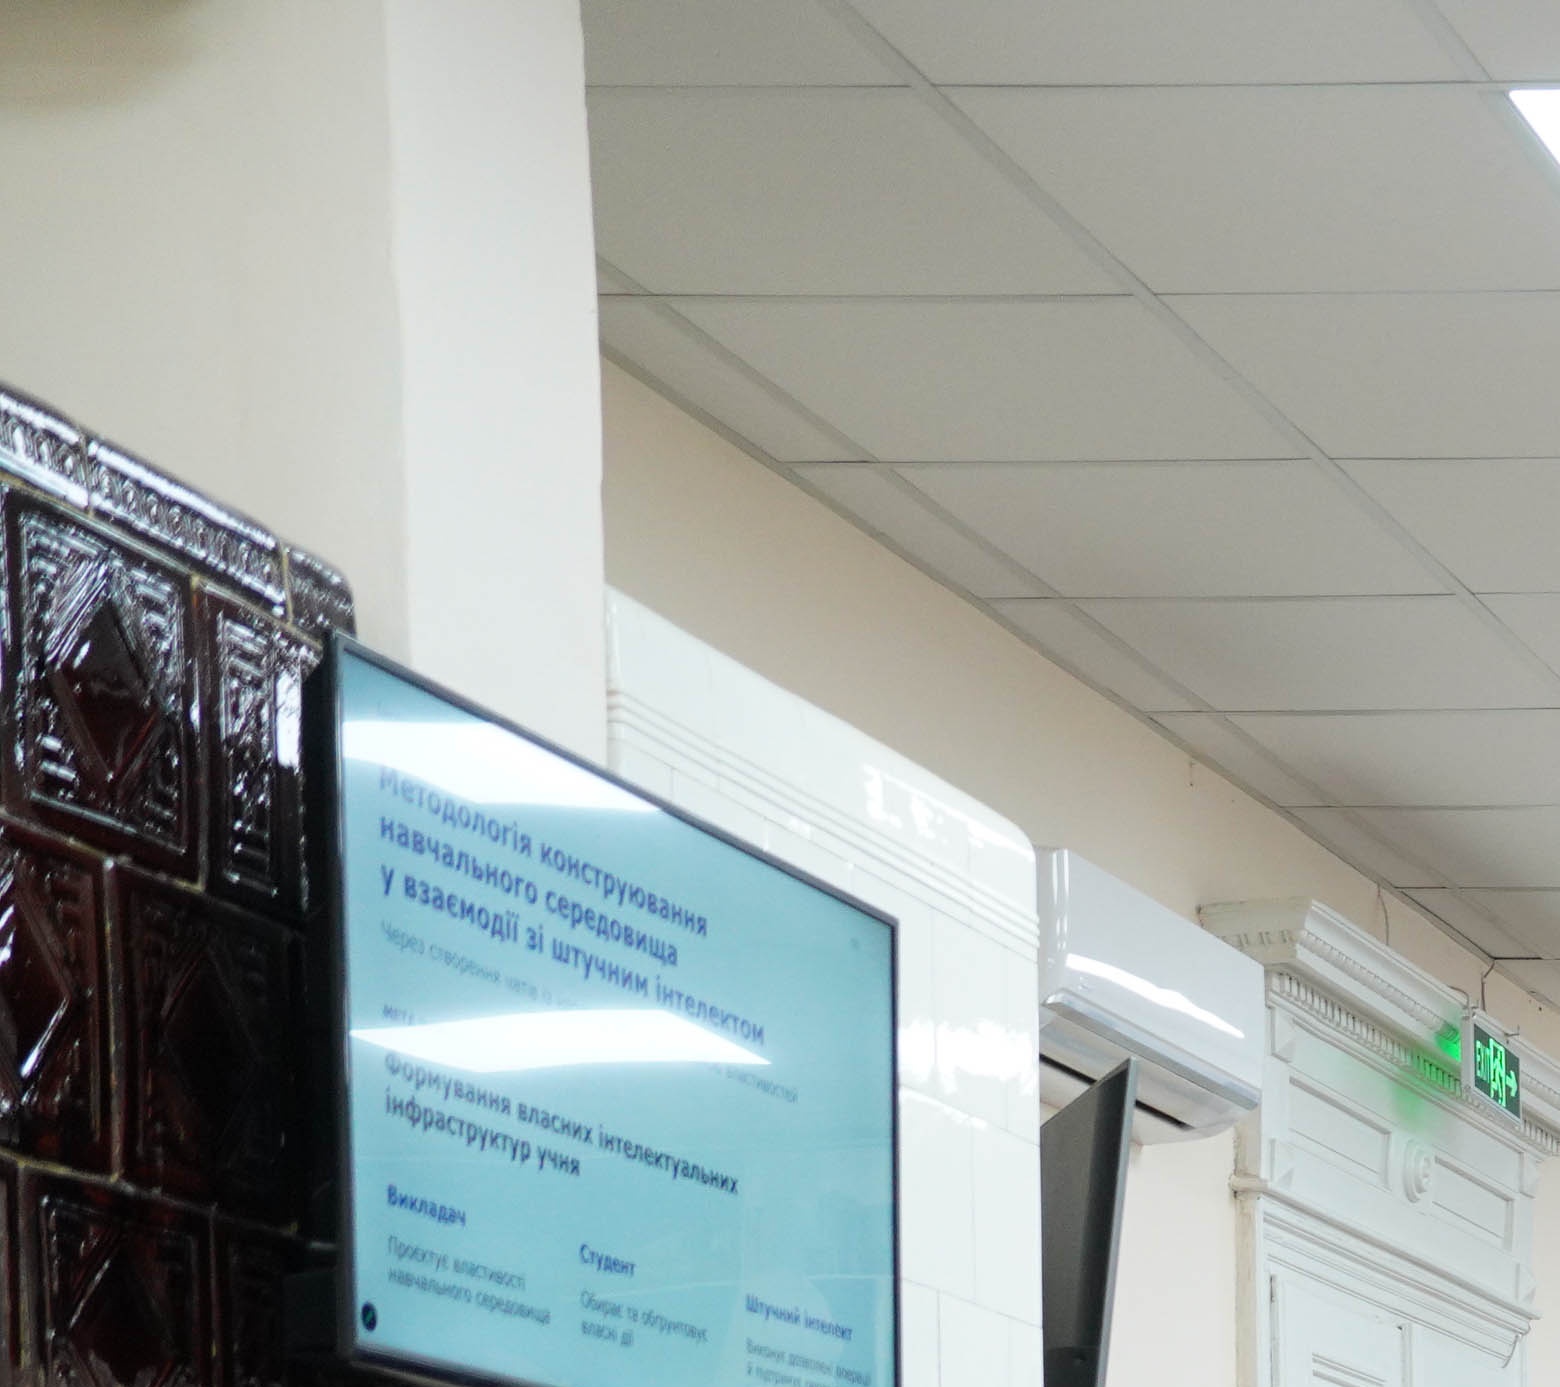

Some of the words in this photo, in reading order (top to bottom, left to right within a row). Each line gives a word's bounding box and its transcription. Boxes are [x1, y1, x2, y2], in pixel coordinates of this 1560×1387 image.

[380, 766, 532, 858] Методологія
[540, 842, 708, 938] конструювання
[380, 816, 539, 904] навчального
[545, 888, 678, 966] середовища
[403, 874, 520, 943] взаємодії
[526, 923, 544, 954] зі
[552, 937, 649, 998] штучним
[1476, 1039, 1490, 1084] EXIT
[384, 1051, 512, 1115] Формування
[517, 1100, 594, 1145] власних
[598, 1123, 739, 1195] інтелектуальних
[384, 1085, 532, 1165] інфраструктур
[536, 1144, 581, 1177] учня
[387, 1183, 466, 1227] Викладач
[579, 1243, 636, 1276] Студент
